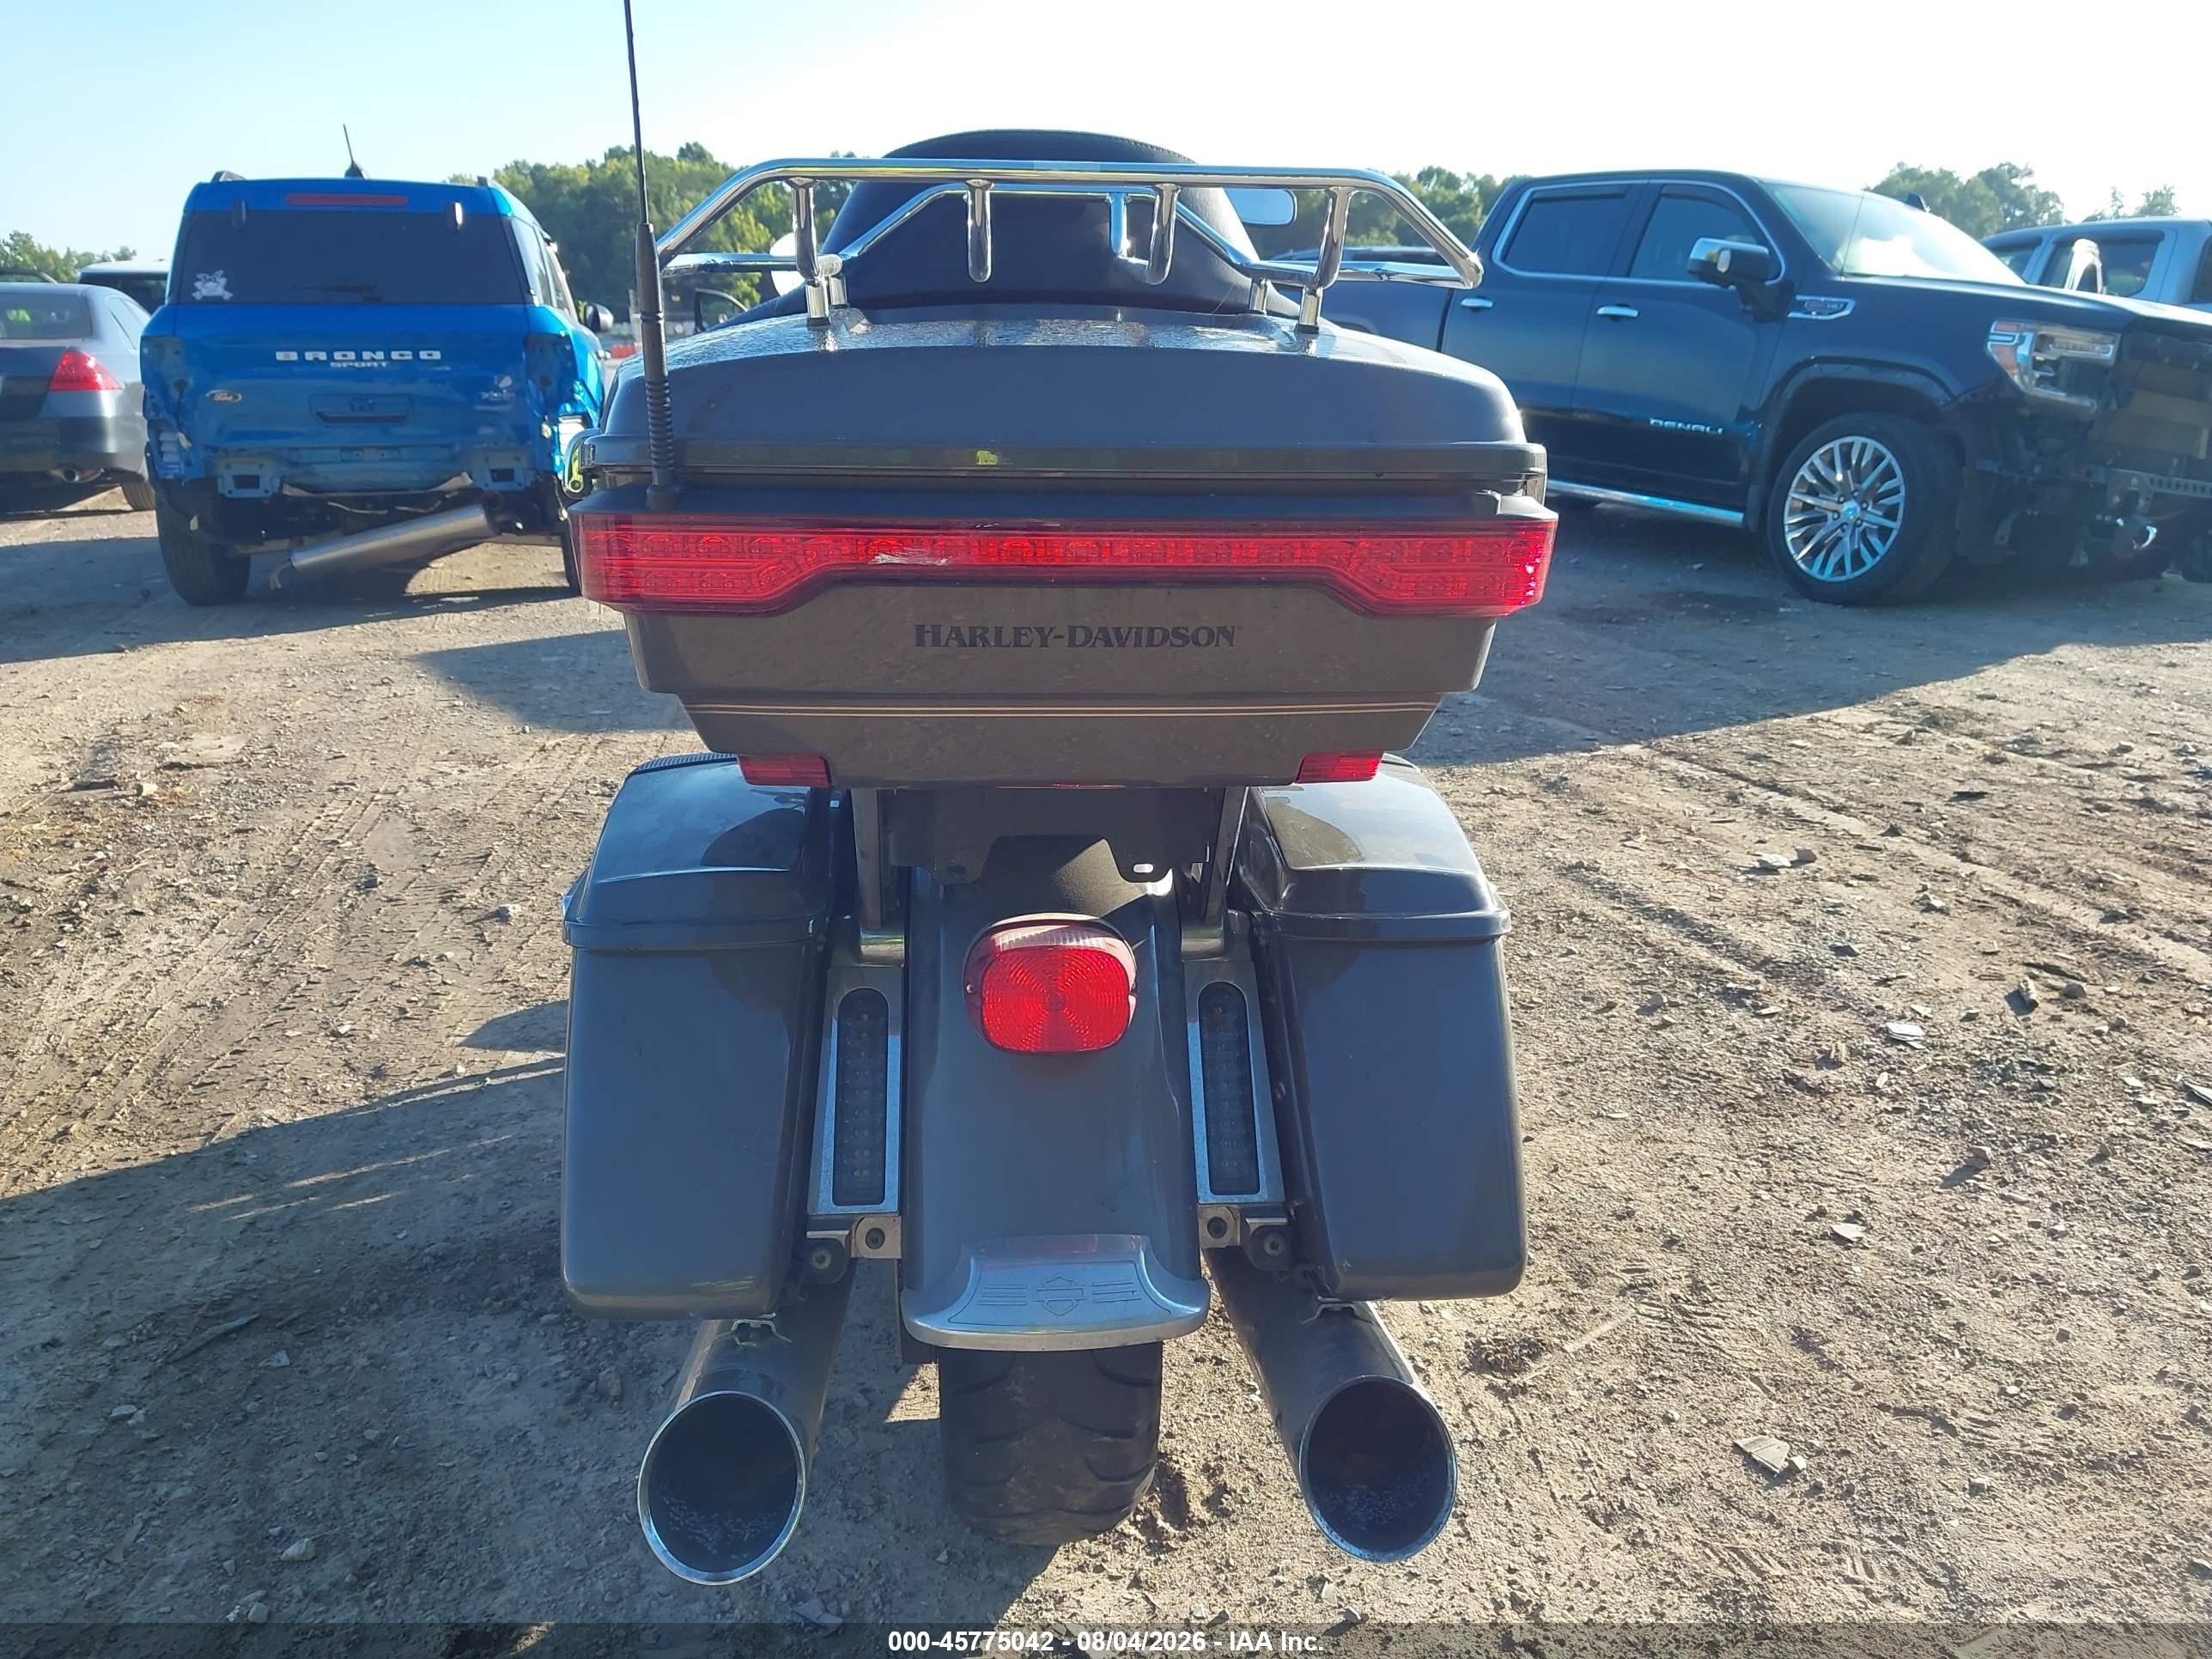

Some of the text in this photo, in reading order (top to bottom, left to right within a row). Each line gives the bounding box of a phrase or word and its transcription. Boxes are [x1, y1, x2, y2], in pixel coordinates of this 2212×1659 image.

[275, 349, 442, 362] BRONCO
[1650, 418, 1723, 435] DENALI
[913, 624, 1237, 648] HARLEY-DAVIDSON
